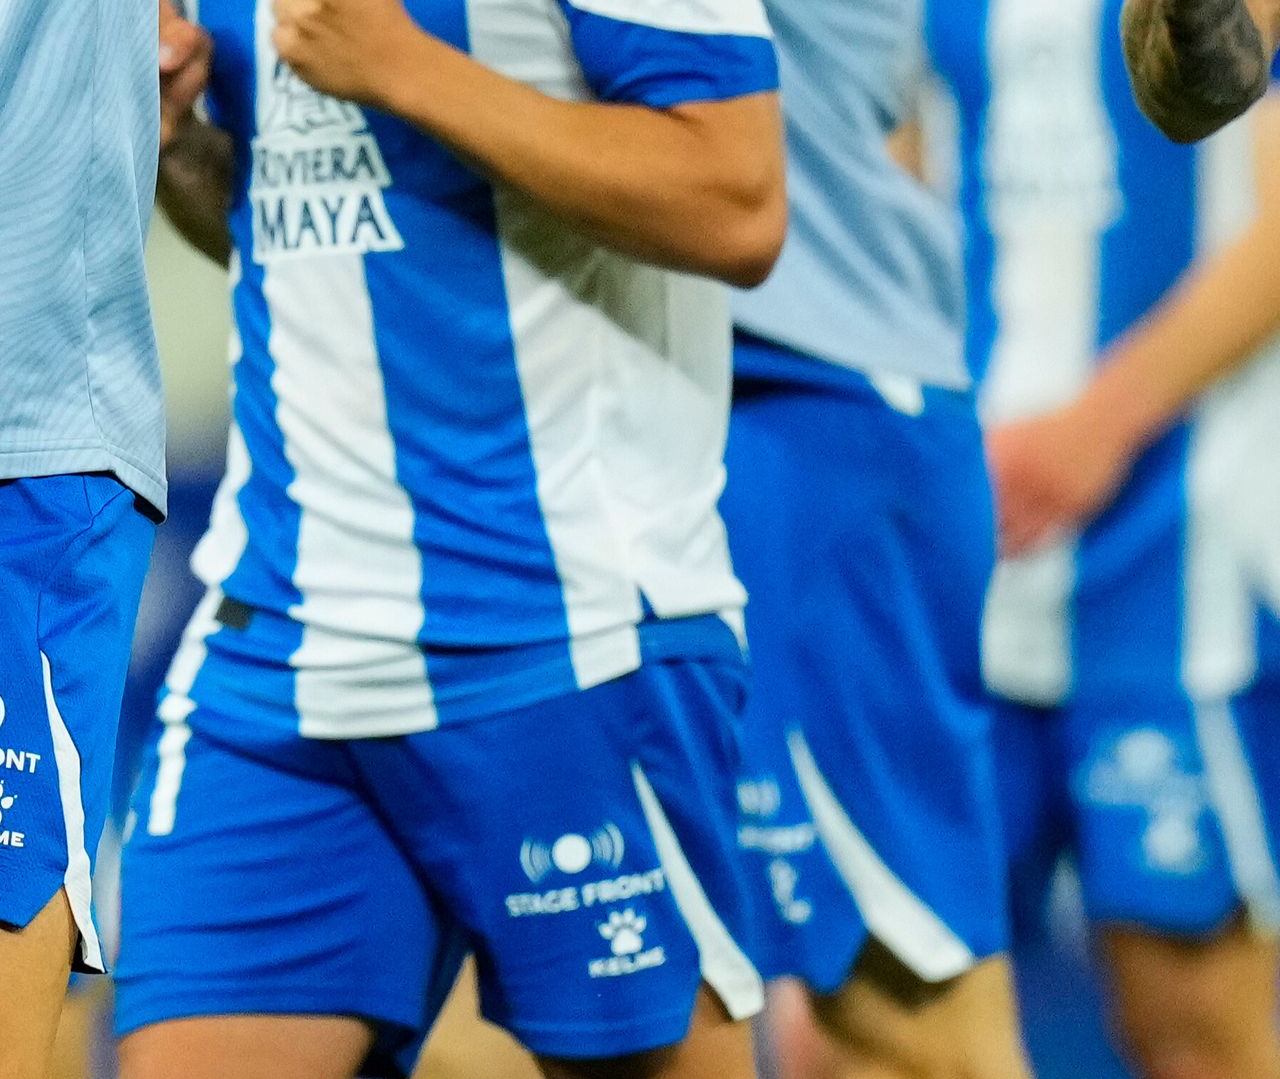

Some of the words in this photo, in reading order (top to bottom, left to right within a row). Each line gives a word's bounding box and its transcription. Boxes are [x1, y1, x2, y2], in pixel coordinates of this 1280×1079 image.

[258, 144, 377, 188] RIVIERA
[256, 194, 387, 251] MAYA
[505, 886, 580, 917] STAGE
[581, 870, 664, 907] FRONT
